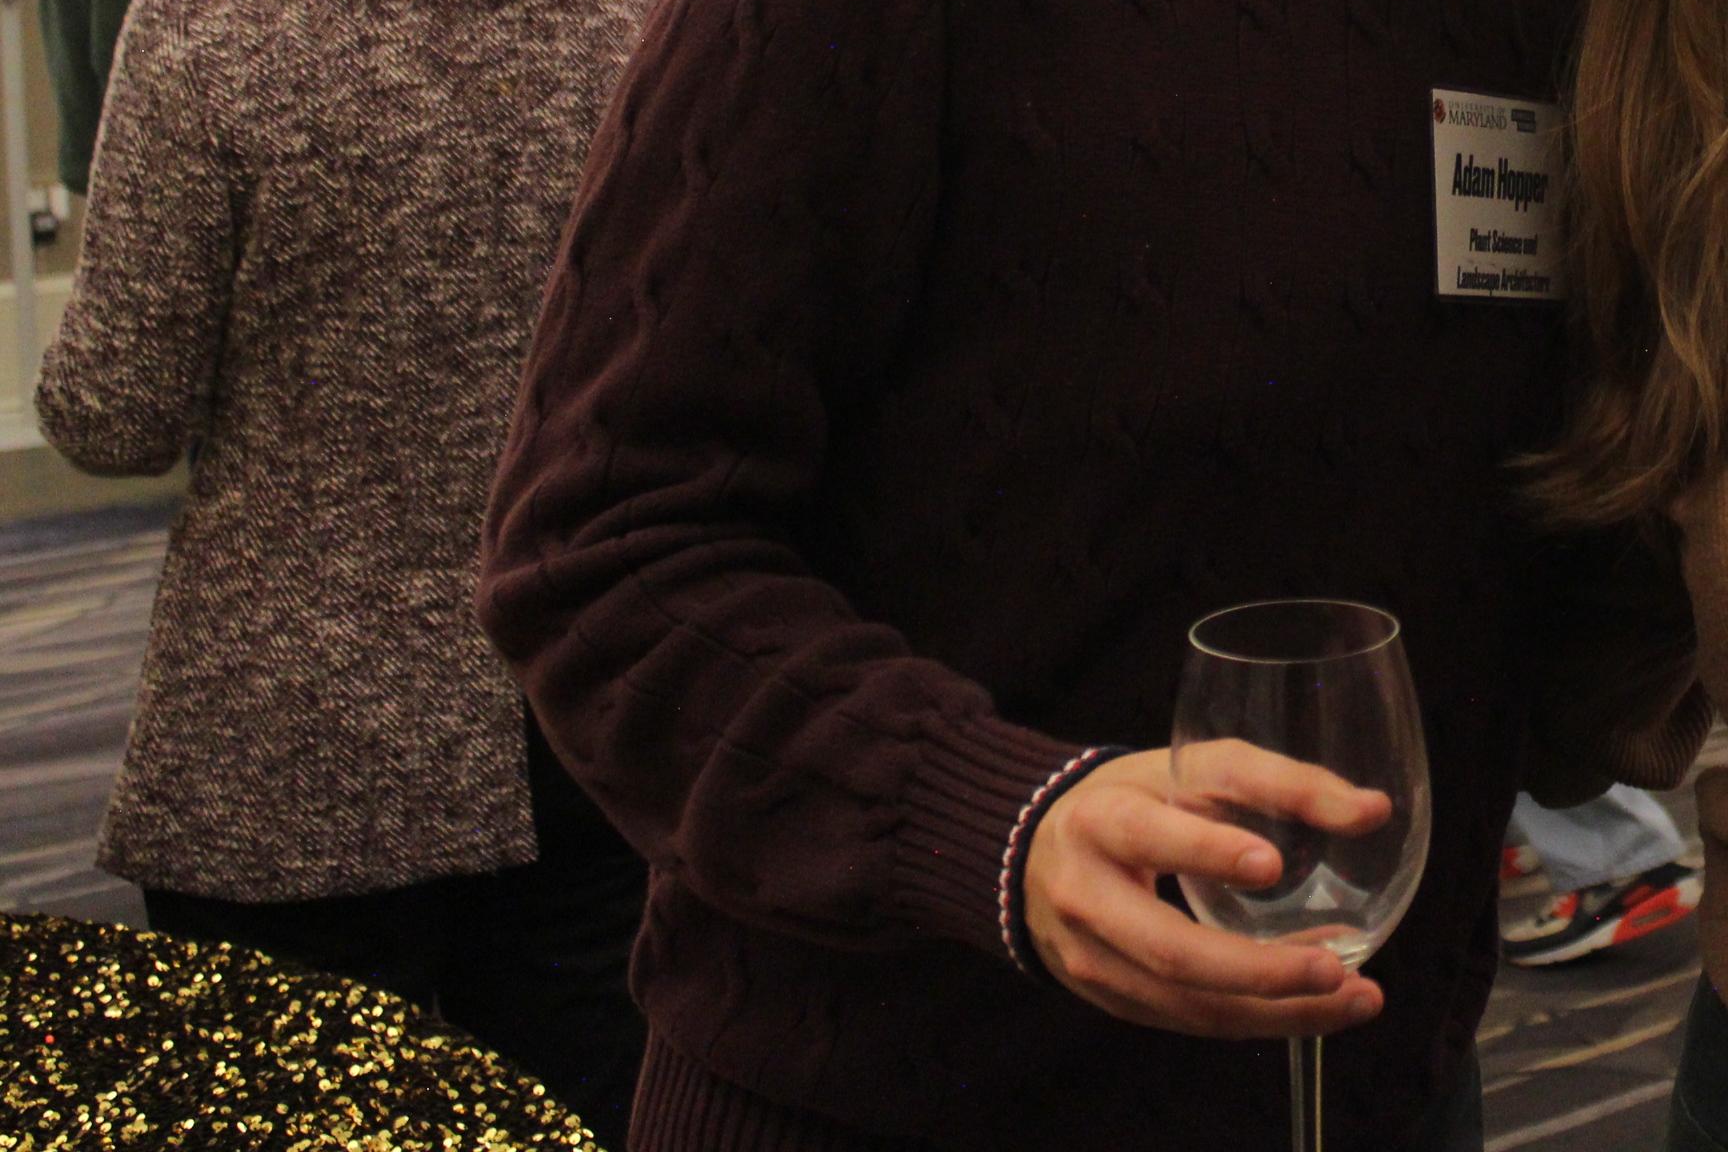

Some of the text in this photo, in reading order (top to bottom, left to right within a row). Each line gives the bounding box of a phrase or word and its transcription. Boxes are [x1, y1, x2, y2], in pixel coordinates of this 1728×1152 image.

[1449, 110, 1507, 129] MARYLAND
[1452, 153, 1548, 212] Adam Hopper
[1470, 228, 1538, 255] Plant Science and
[1457, 266, 1500, 296] Landscape
